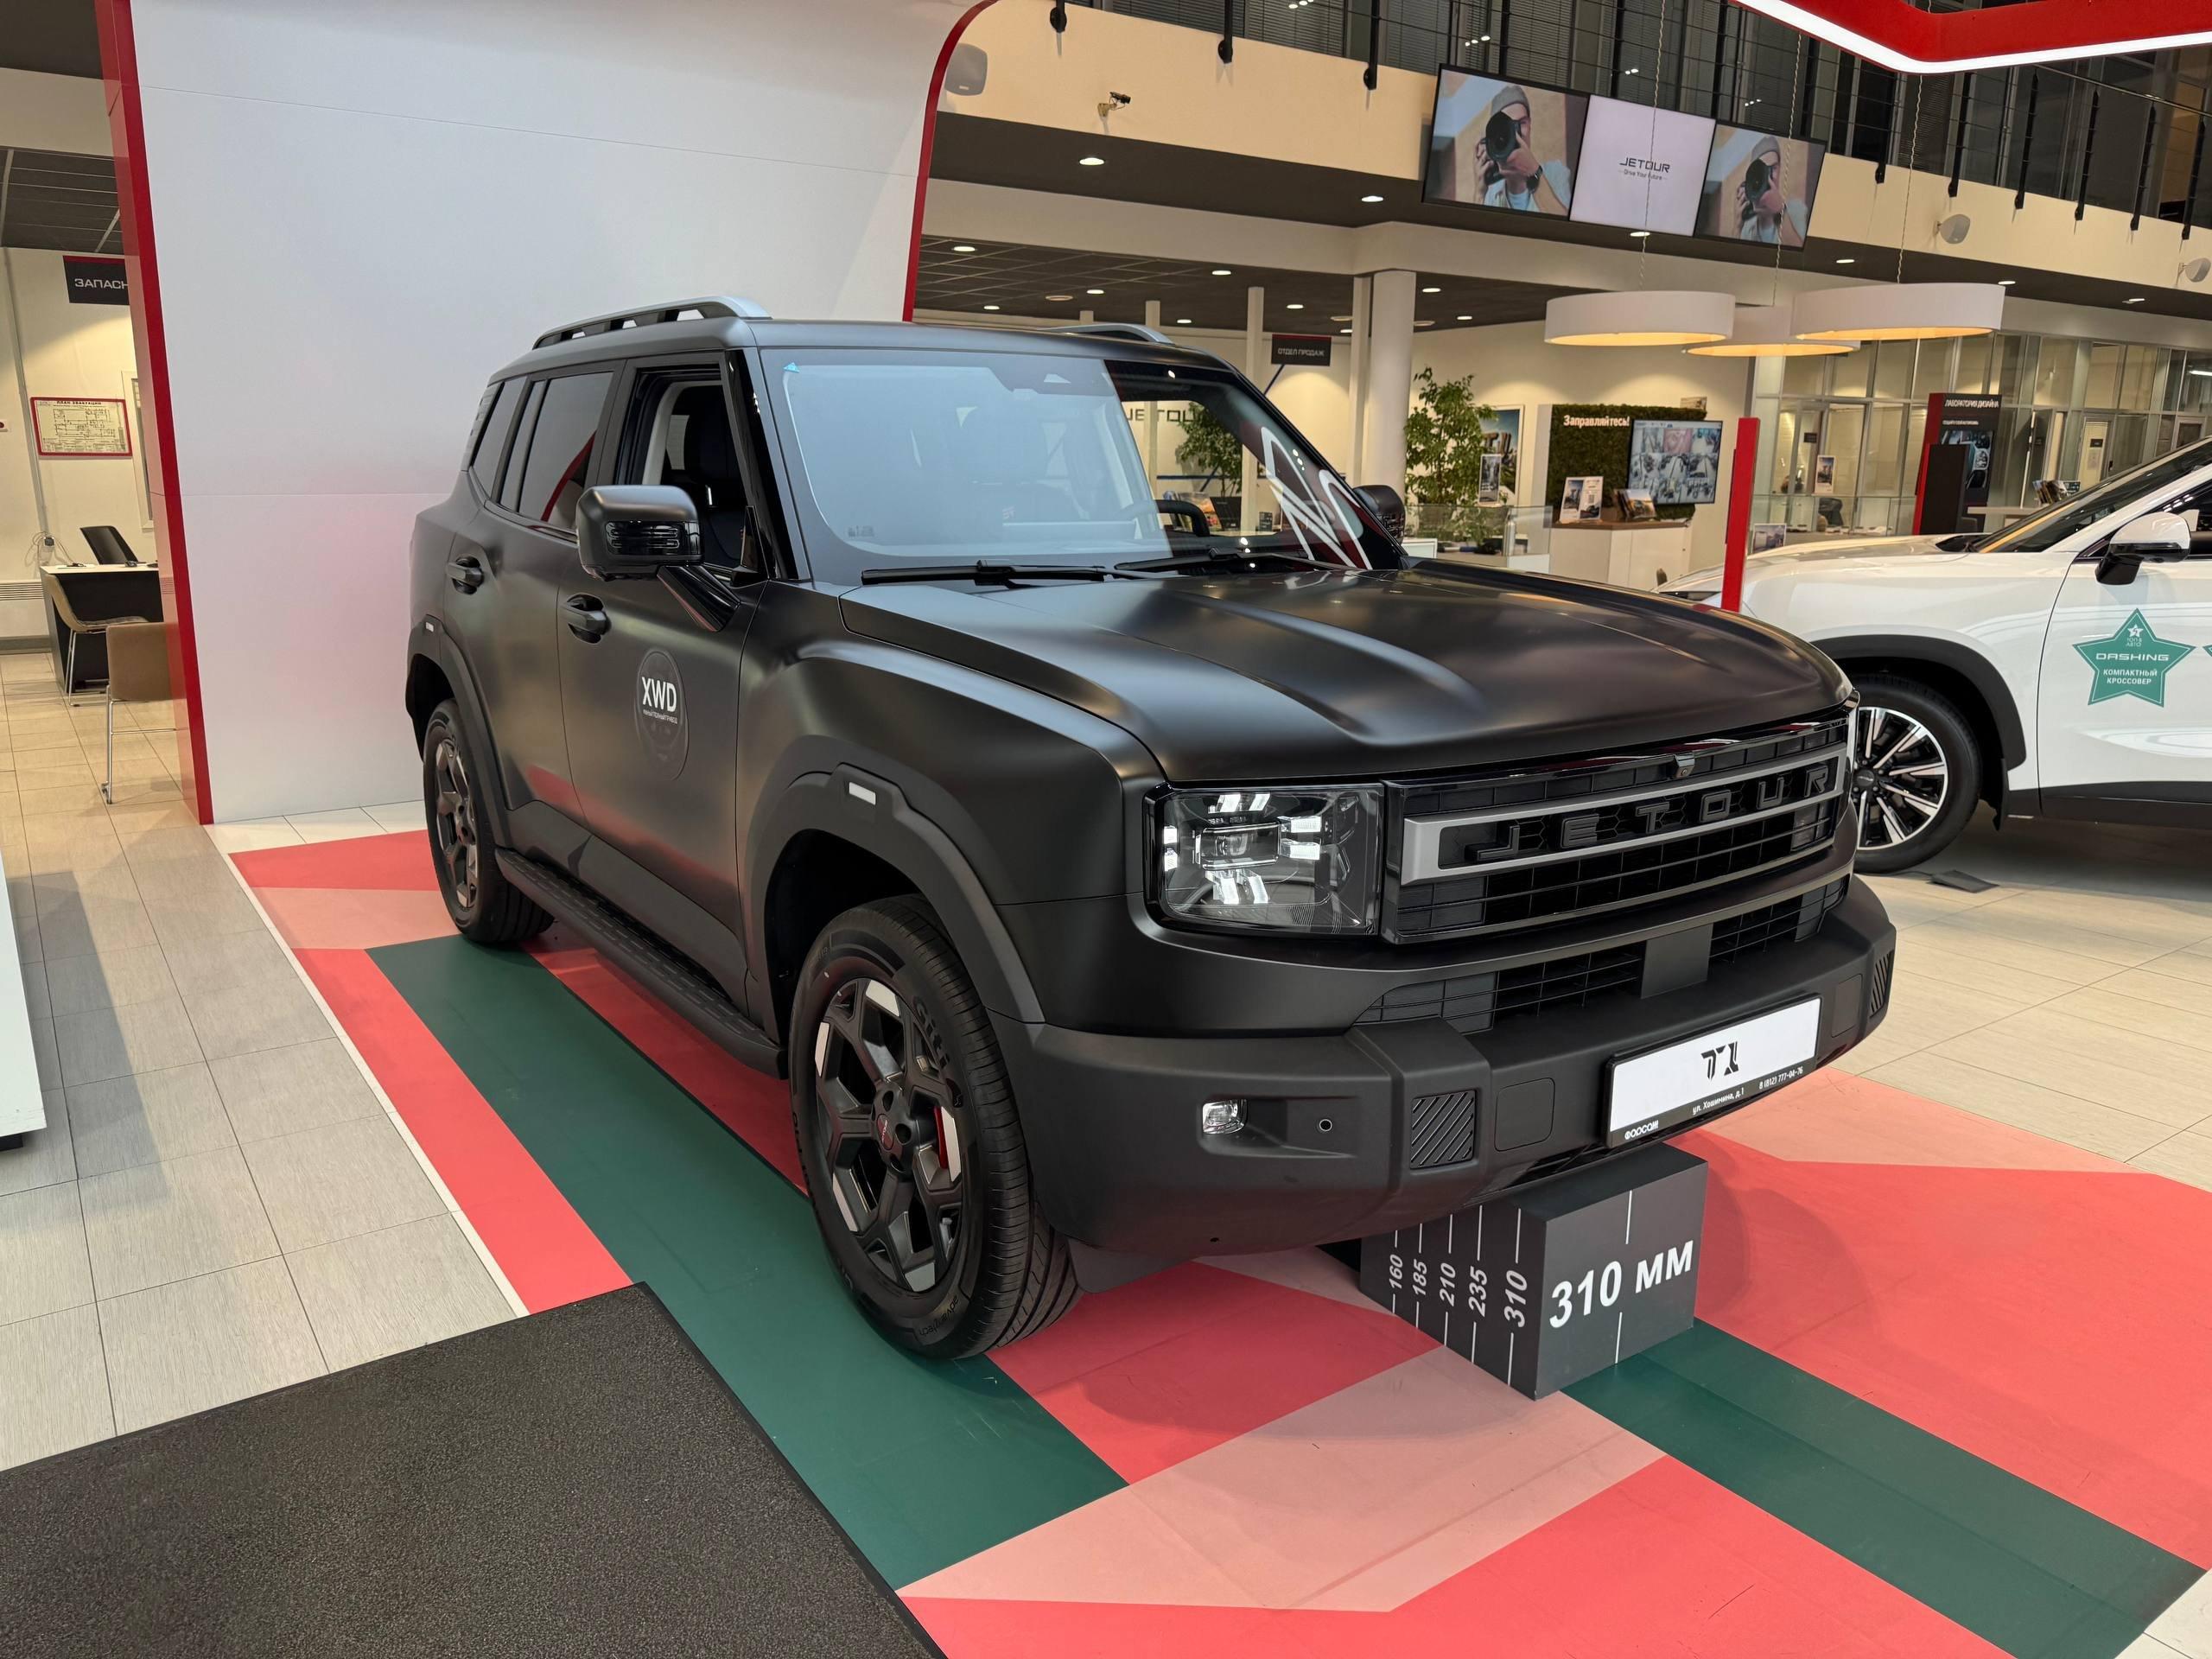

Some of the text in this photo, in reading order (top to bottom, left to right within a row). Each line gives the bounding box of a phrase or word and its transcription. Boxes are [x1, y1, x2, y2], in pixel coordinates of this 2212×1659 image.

[1619, 157, 1670, 173] JETOUR
[1277, 347, 1325, 357] ОТДЕЛ ПРОДАЖ
[2103, 668, 2158, 677] КОМПАКТНЫЙ
[641, 677, 677, 713] XWD
[1466, 763, 1830, 861] JETOUR
[1758, 1081, 1764, 1090] 8
[1764, 1076, 1777, 1088] (812)
[1692, 1105, 1702, 1116] ул.
[1389, 1253, 1404, 1290] 160
[1412, 1258, 1428, 1297] 185
[1439, 1262, 1457, 1308] 210
[1468, 1265, 1488, 1318] 235
[1503, 1269, 1529, 1328] 310
[1548, 1261, 1622, 1329] 310
